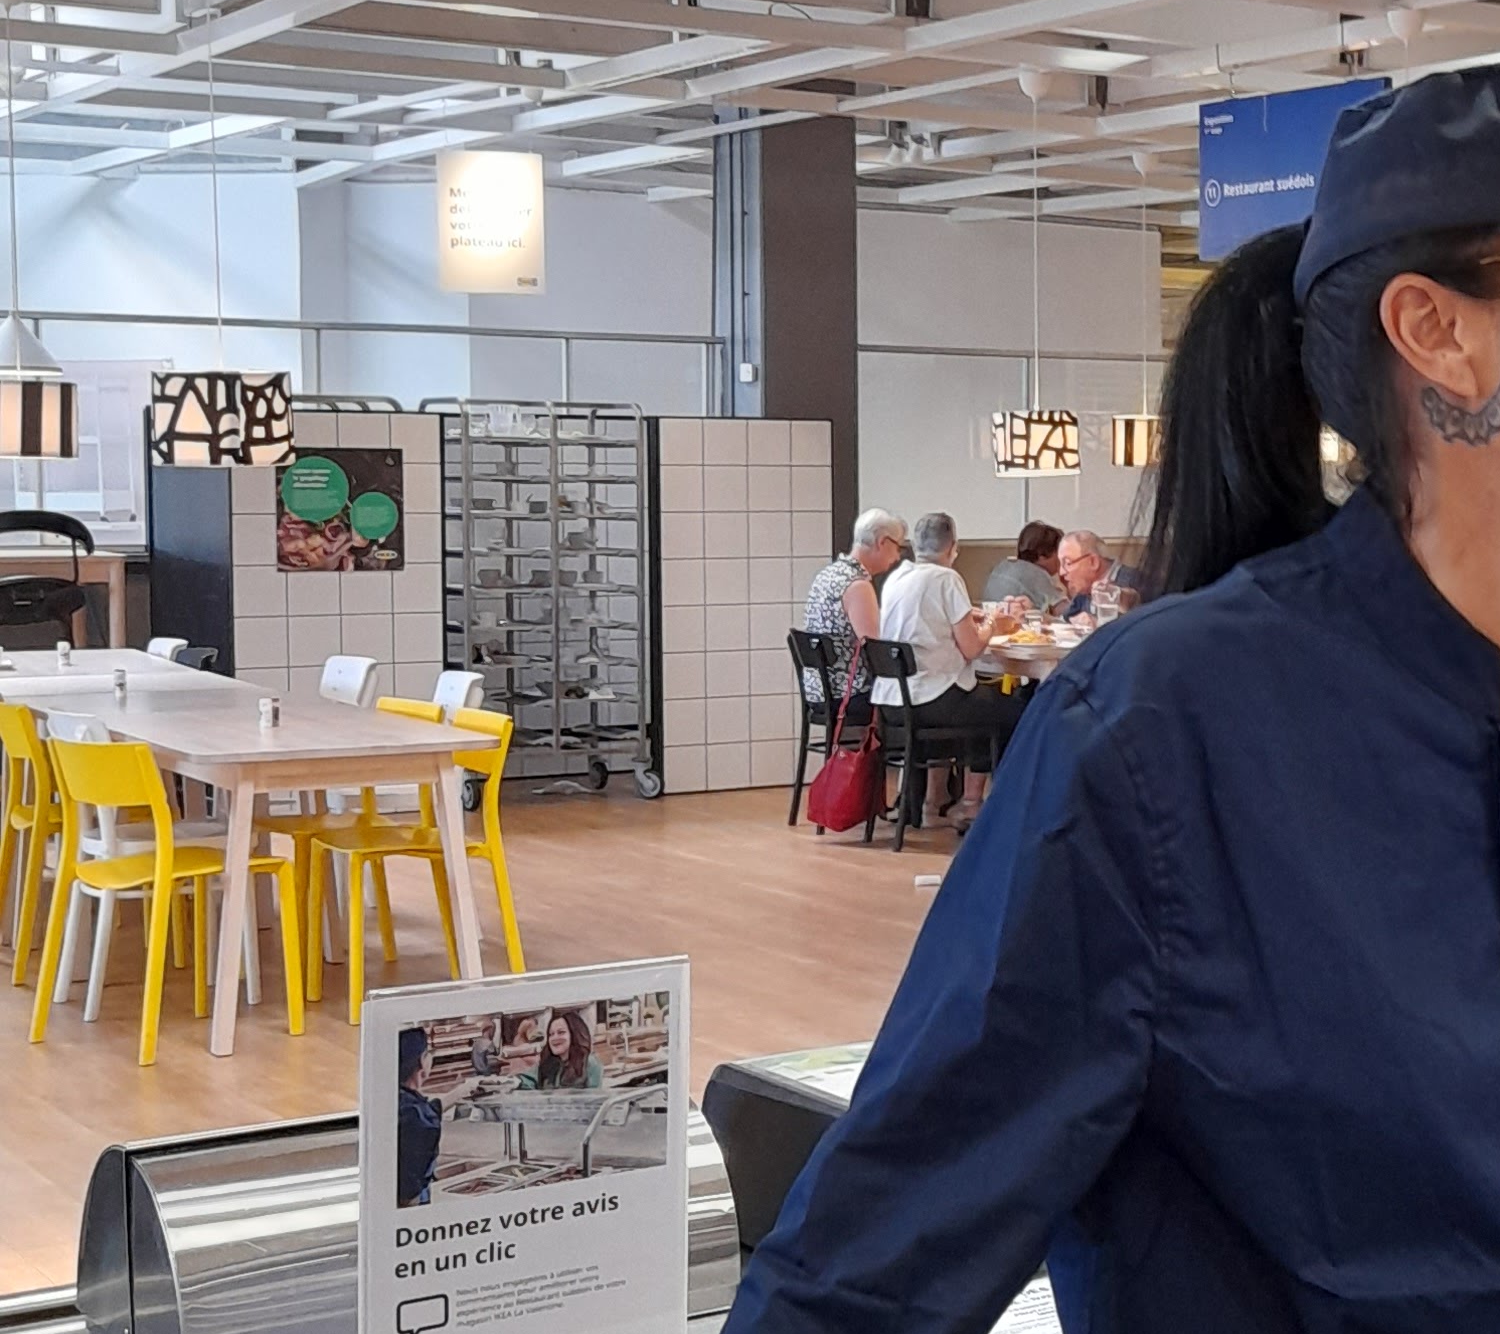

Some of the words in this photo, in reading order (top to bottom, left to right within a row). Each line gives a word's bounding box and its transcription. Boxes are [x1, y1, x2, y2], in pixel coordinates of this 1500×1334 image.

[1223, 179, 1275, 197] Restaurant
[396, 1217, 492, 1248] Donnez
[499, 1204, 564, 1230] votre
[572, 1193, 619, 1217] avis
[394, 1258, 425, 1278] en
[435, 1252, 466, 1272] un
[475, 1241, 516, 1264] clic
